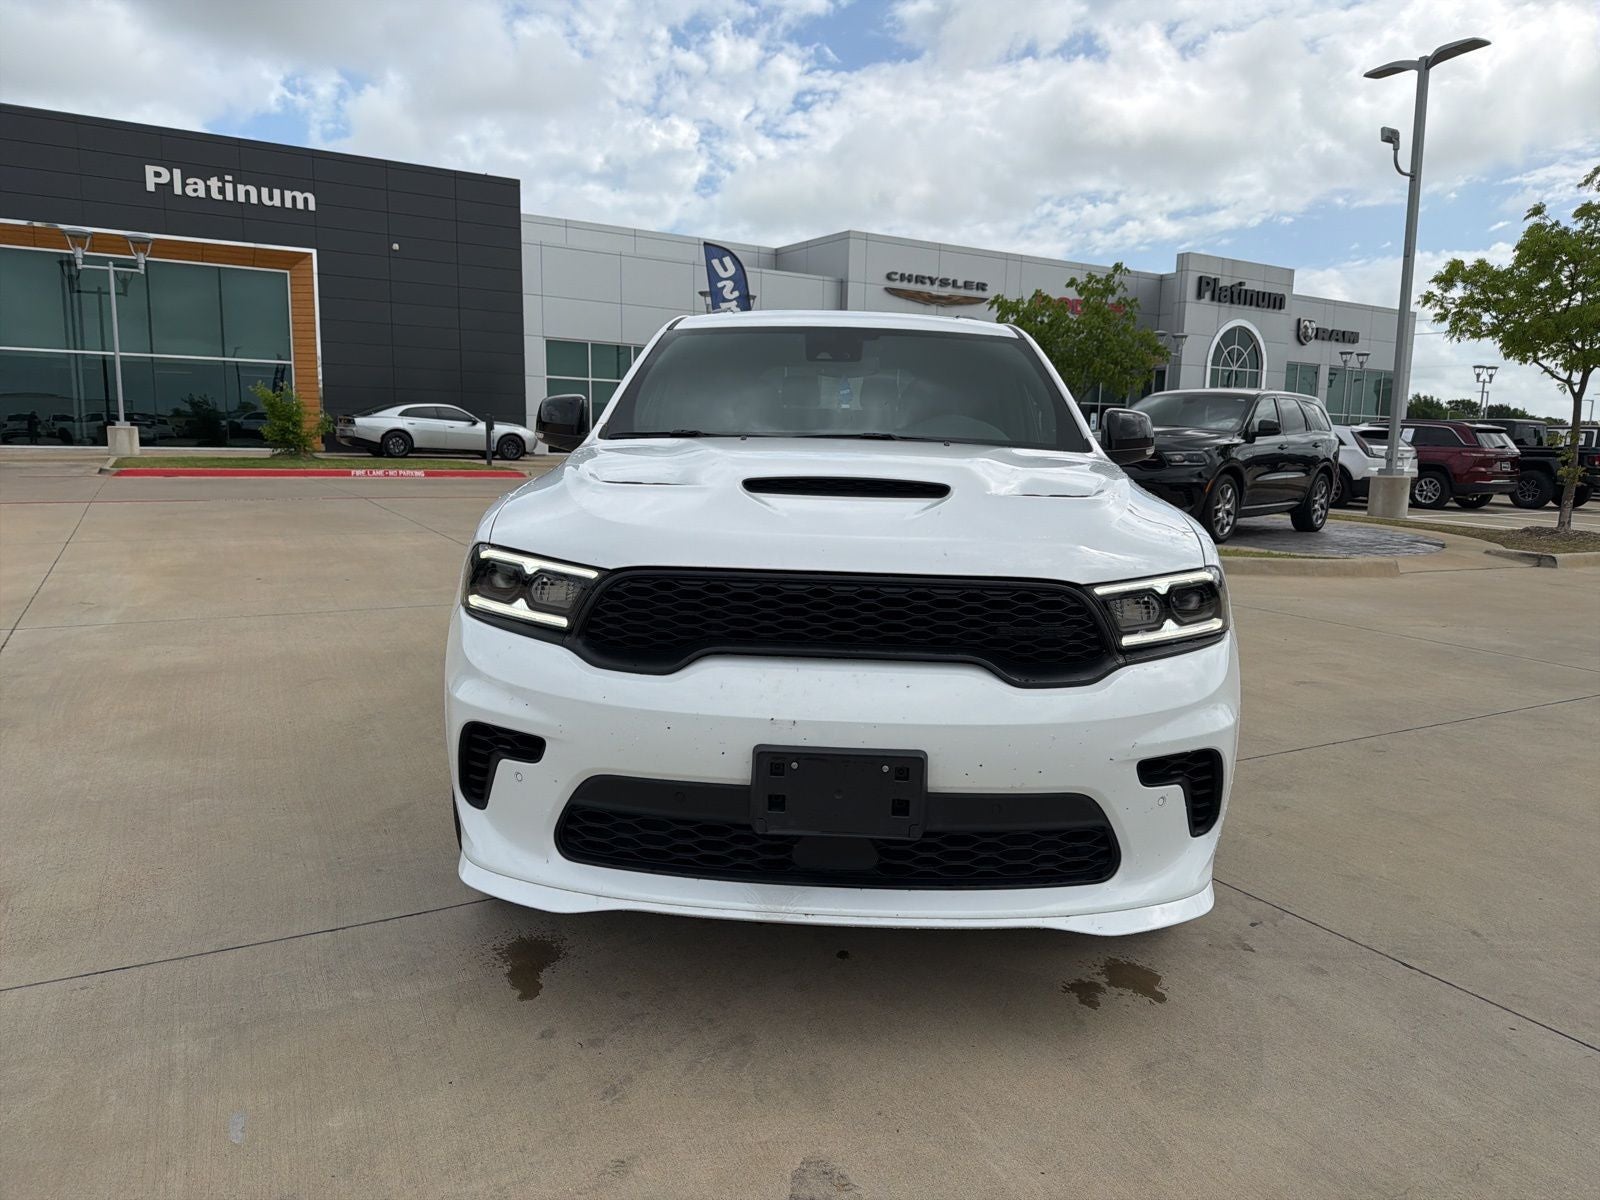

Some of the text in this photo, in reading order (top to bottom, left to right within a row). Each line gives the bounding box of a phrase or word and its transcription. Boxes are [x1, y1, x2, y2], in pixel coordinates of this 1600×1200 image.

[144, 164, 317, 212] Platinum
[885, 270, 989, 292] CHRYSLER
[1197, 275, 1287, 311] Platinum
[1315, 327, 1361, 344] RAM
[398, 469, 425, 478] PARKING
